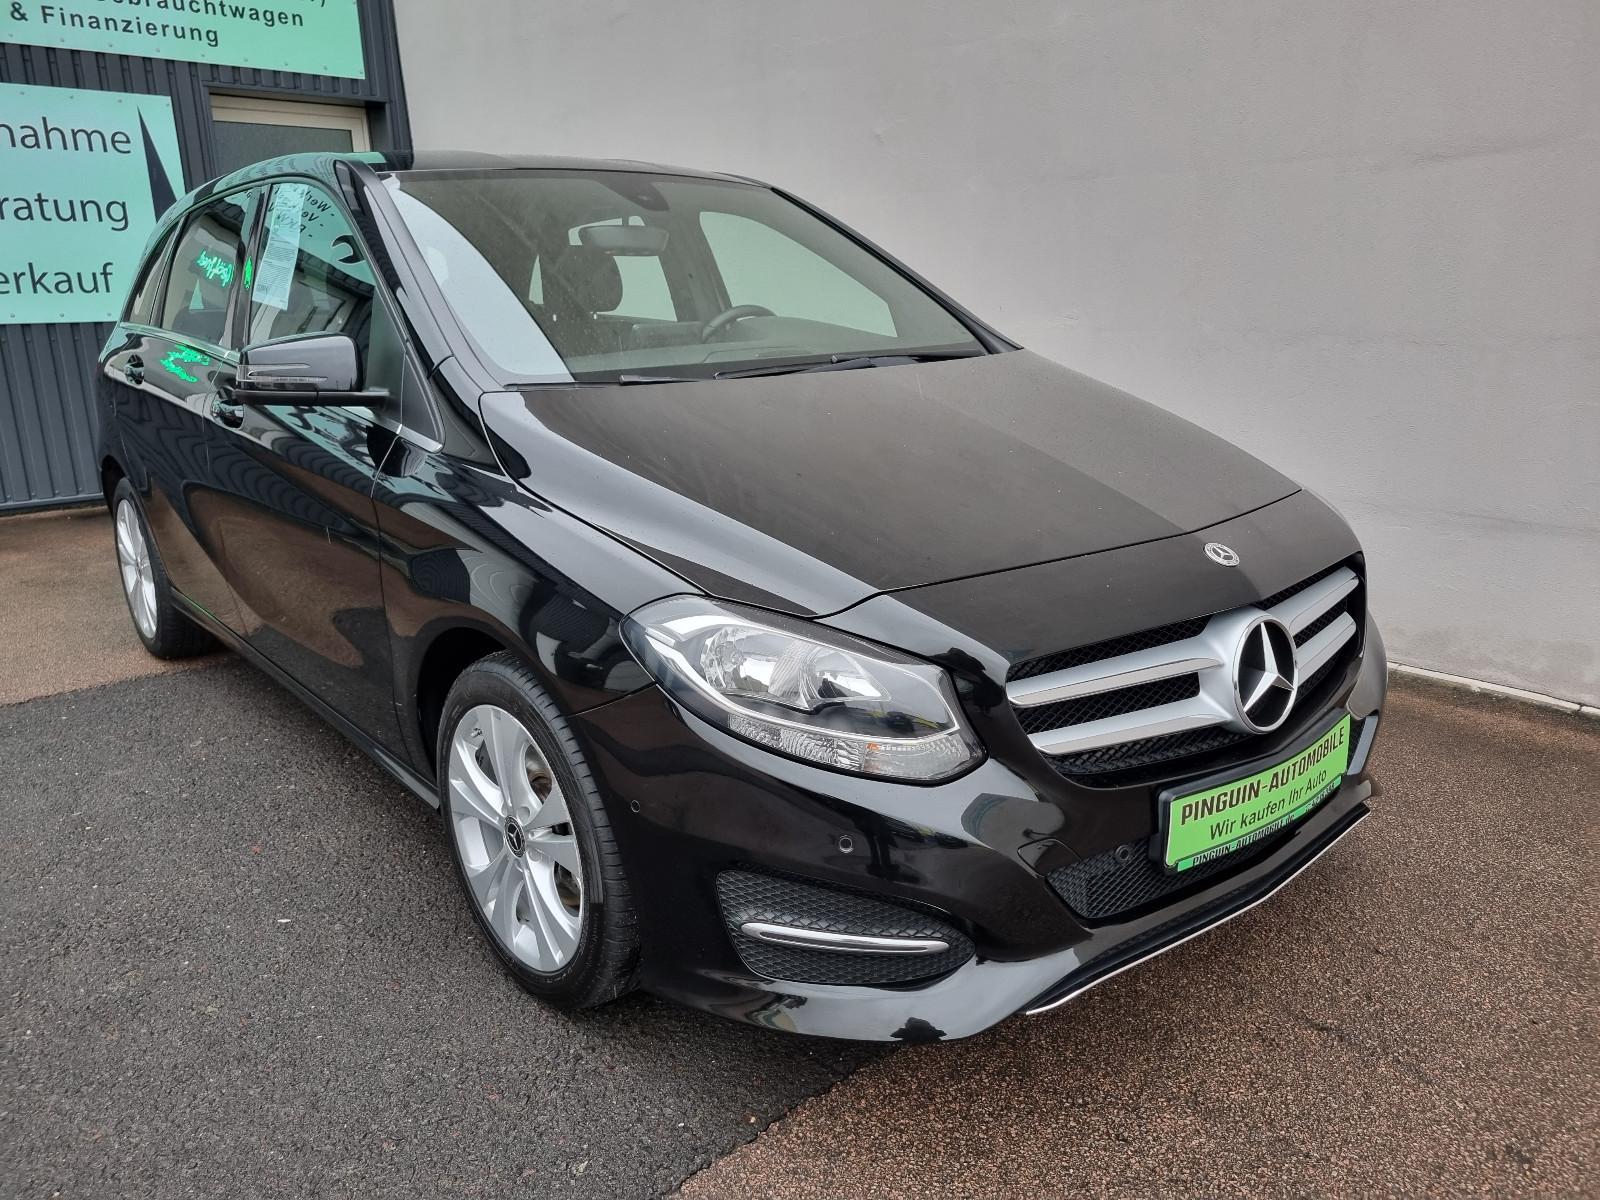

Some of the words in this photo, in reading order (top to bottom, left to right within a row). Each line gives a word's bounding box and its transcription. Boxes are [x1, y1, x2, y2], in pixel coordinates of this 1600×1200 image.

[10, 1, 29, 22] &
[40, 5, 219, 48] Finanzierung
[0, 116, 132, 154] nahme
[0, 192, 129, 232] ratung
[1180, 726, 1345, 826] PINGUIN-AUTOMOBILE
[1210, 818, 1237, 841] Wir
[1240, 797, 1285, 829] kaufen
[1288, 789, 1303, 806] Ihr
[1304, 769, 1327, 796] Auto
